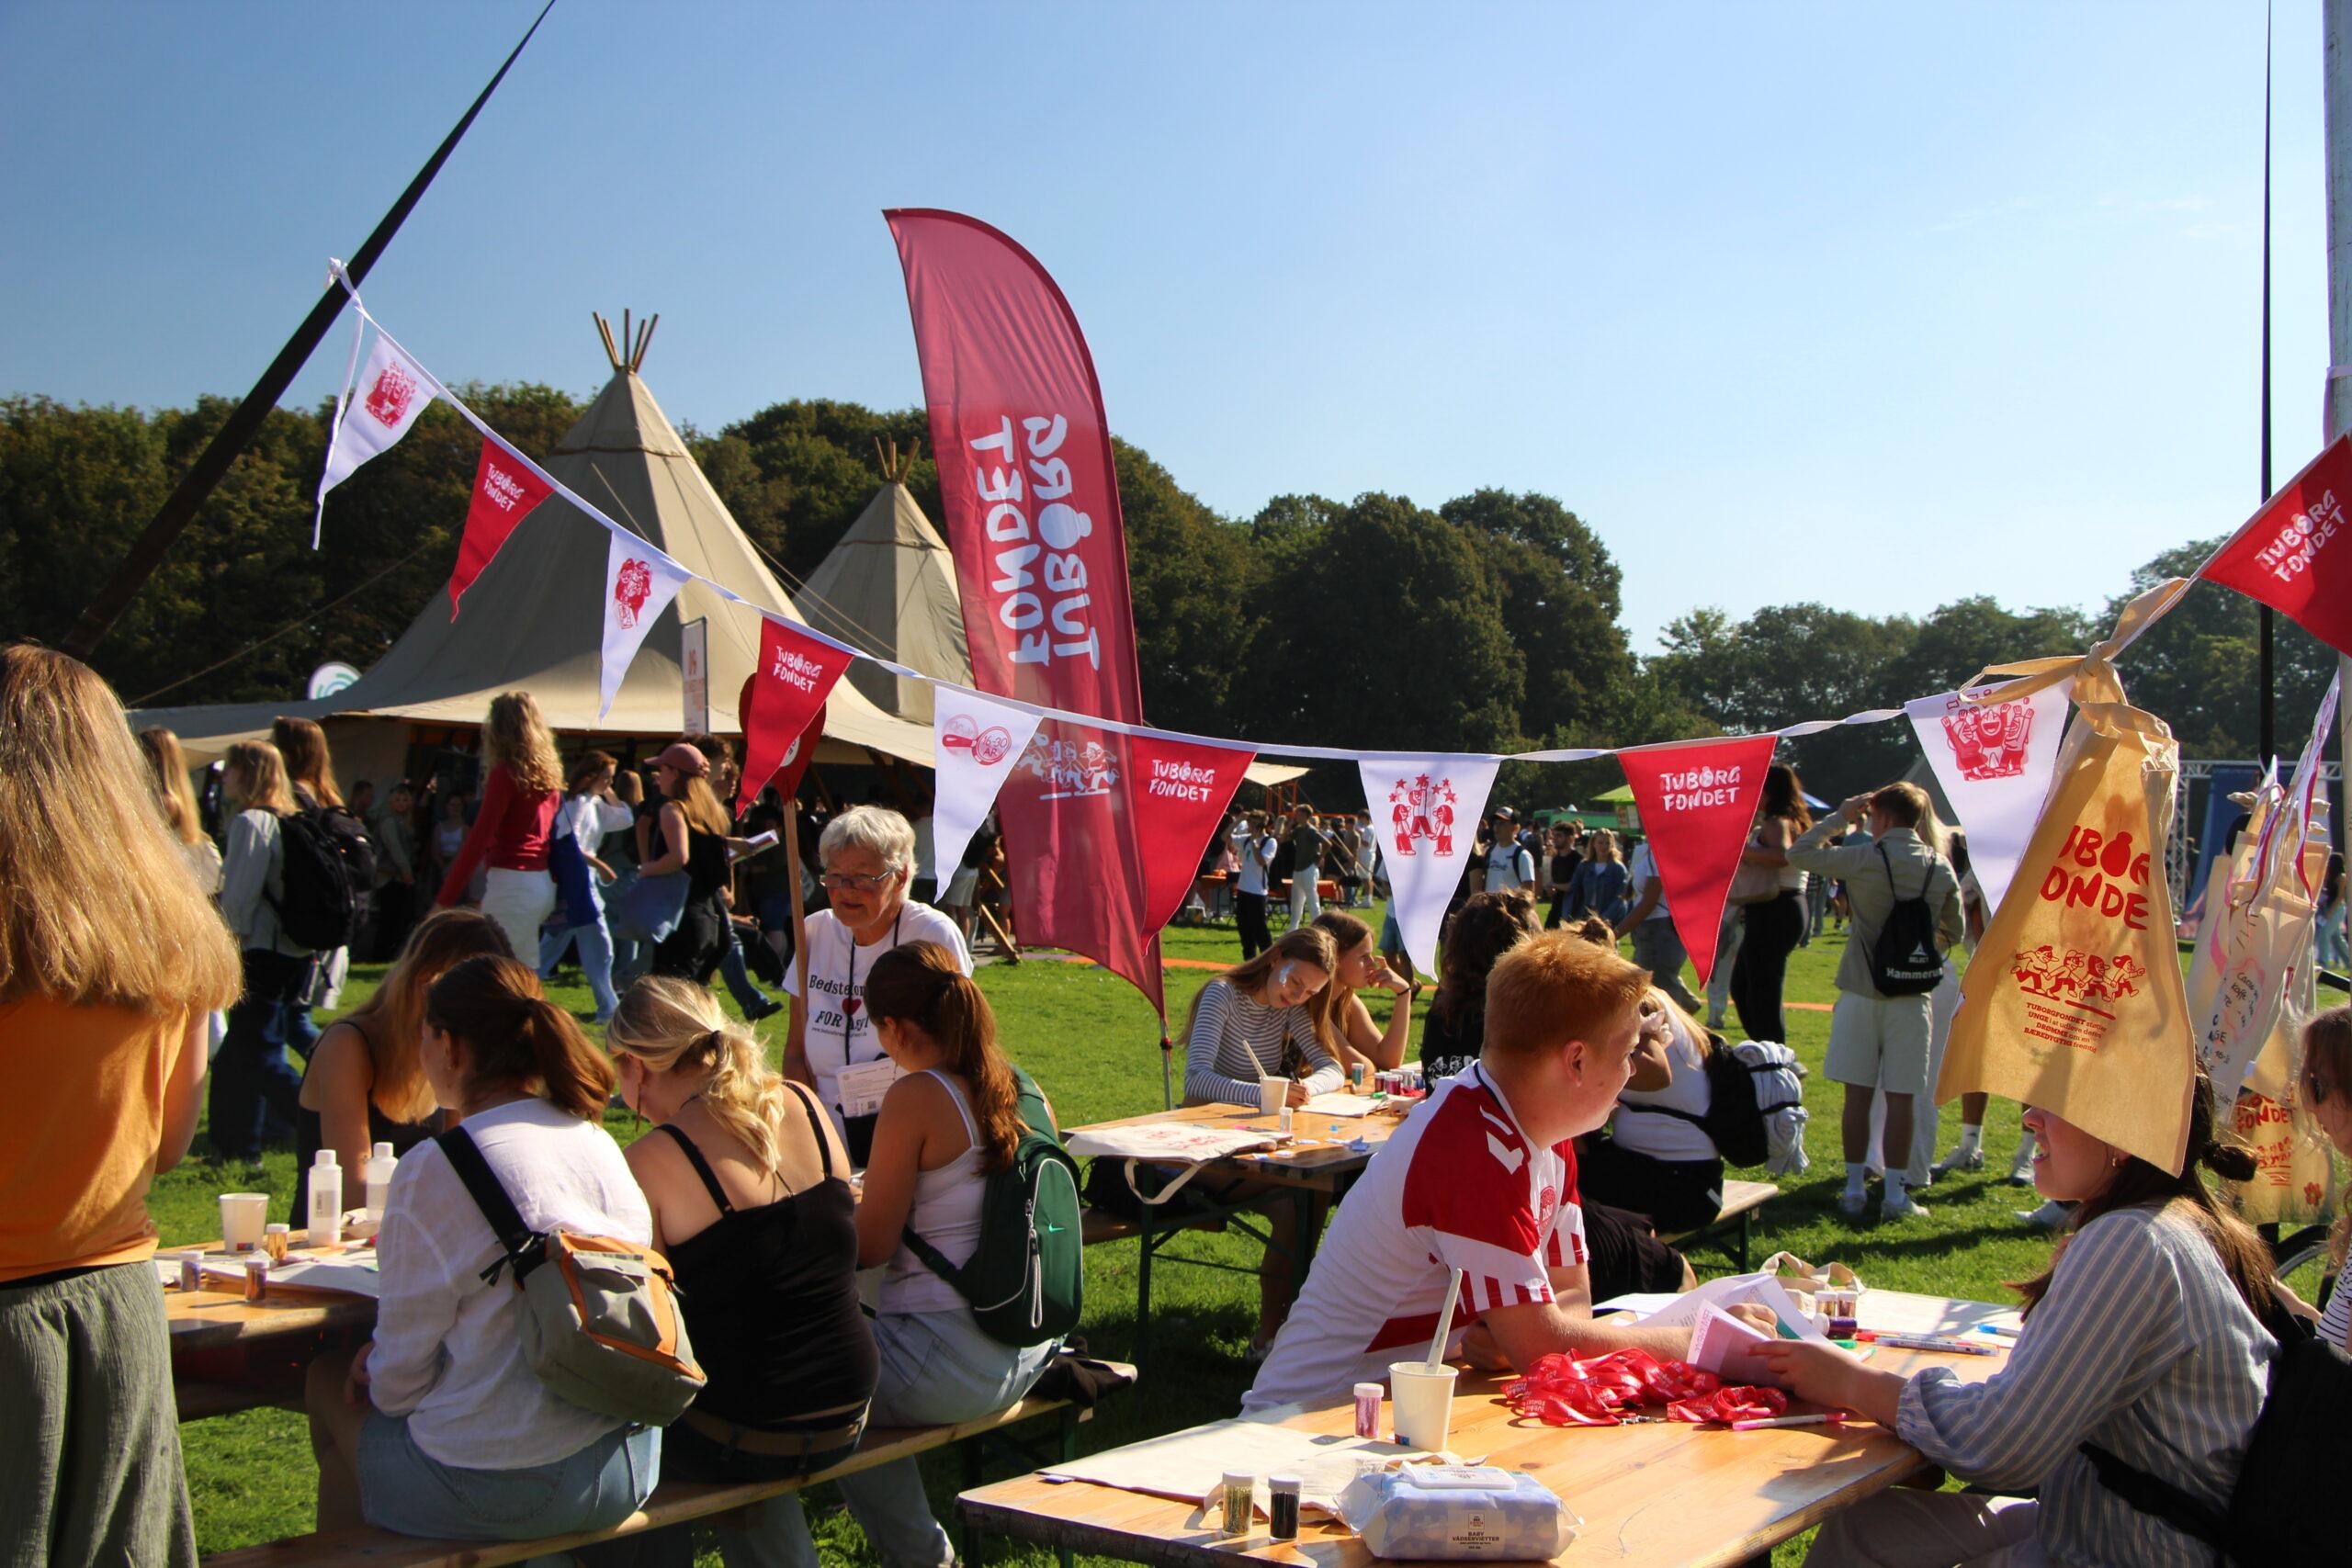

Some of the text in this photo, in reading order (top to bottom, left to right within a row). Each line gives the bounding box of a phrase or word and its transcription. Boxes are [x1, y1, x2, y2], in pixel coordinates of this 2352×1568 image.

[483, 478, 516, 513] FONDET
[487, 462, 526, 500] TUBORG
[2254, 489, 2336, 567] TUBORG
[2273, 505, 2346, 582] FONDET
[775, 645, 823, 679] TUBORG
[773, 662, 817, 694] FONDET
[1152, 759, 1216, 784] TUBORG
[1659, 765, 1741, 792] TUBORG
[1148, 779, 1213, 803] FONDET
[1662, 786, 1741, 812] FONDET
[814, 1010, 843, 1028] FOR
[2028, 1011, 2049, 1023] UNGE
